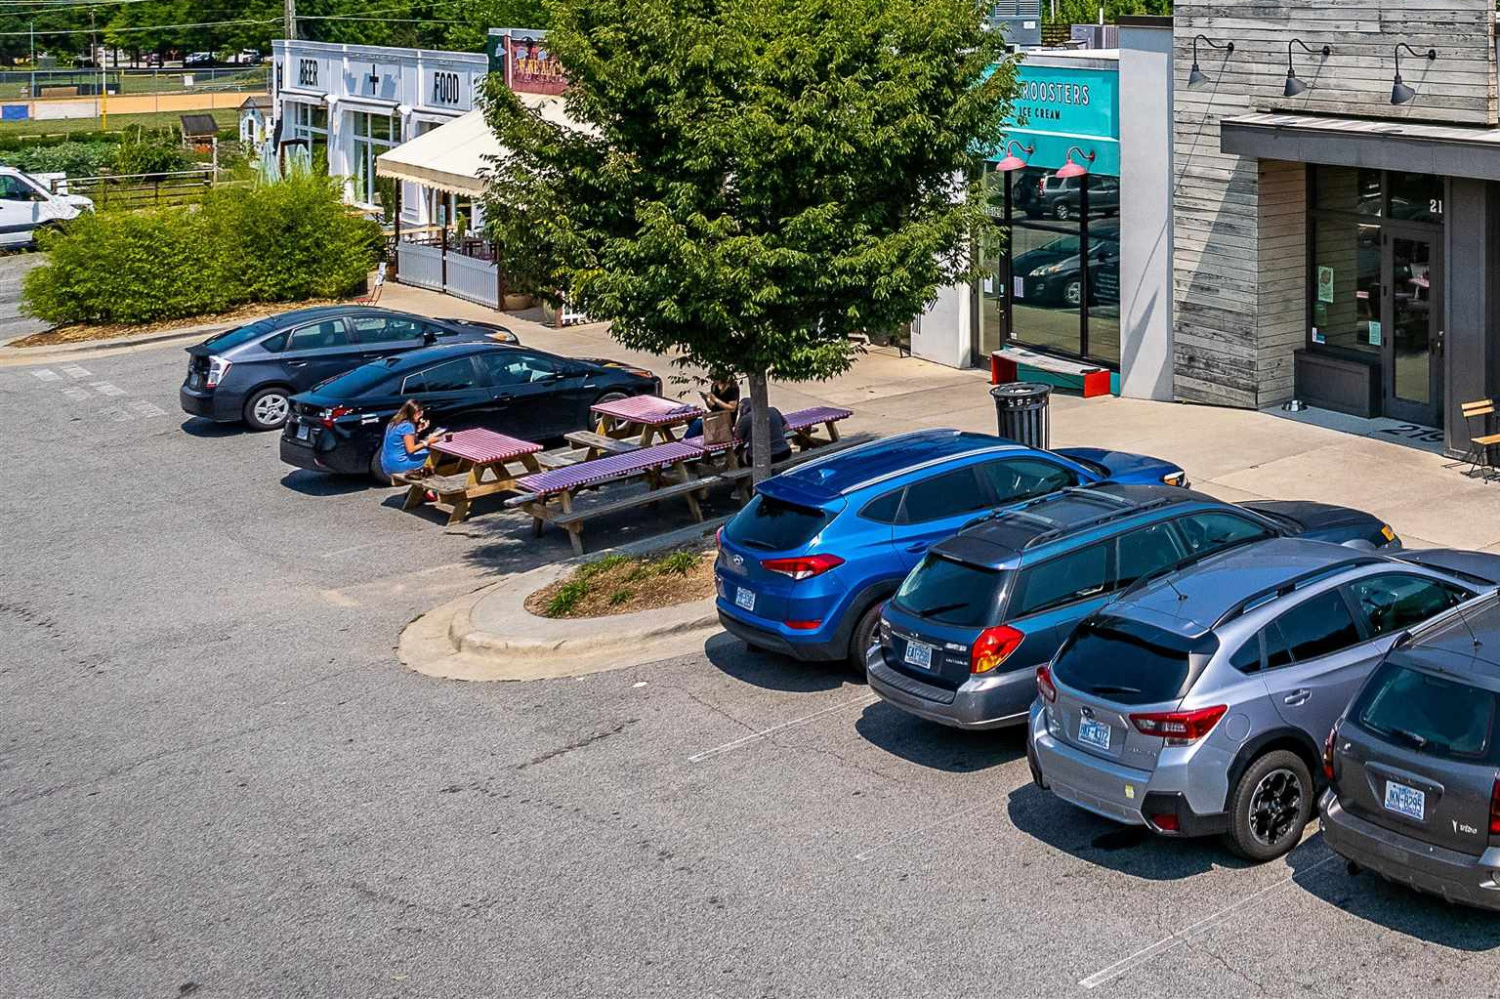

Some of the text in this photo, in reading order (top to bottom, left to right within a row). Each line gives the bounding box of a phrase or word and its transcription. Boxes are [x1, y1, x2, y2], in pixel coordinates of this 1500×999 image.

[300, 59, 318, 86] BEER
[434, 72, 459, 104] FOOD
[1022, 81, 1090, 106] ROOSTERS
[1020, 107, 1061, 120] ICE CREAM
